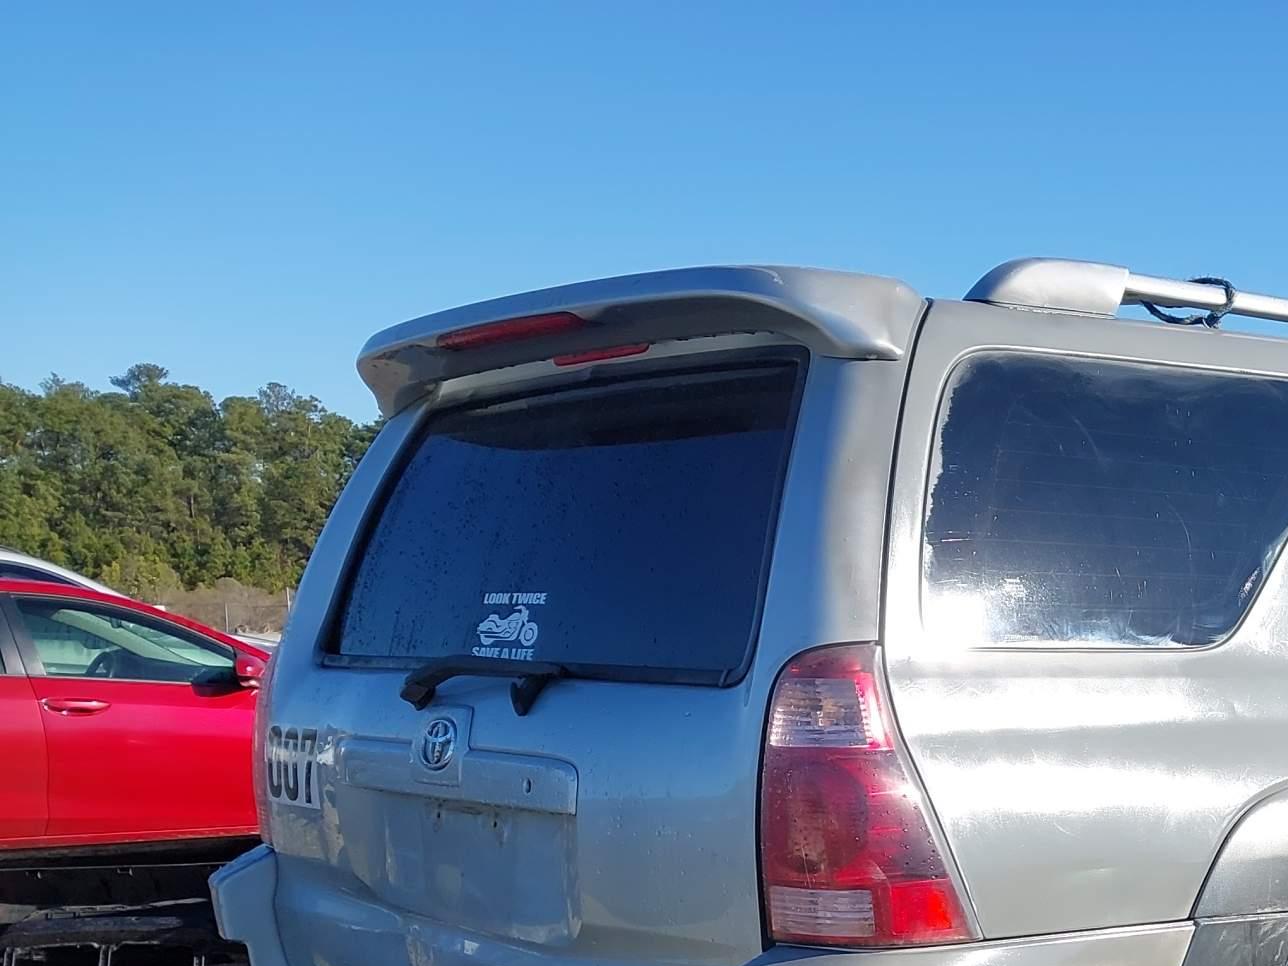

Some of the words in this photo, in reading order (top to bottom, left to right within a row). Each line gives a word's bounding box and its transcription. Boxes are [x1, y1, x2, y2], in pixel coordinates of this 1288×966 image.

[483, 592, 511, 605] LOOK
[512, 592, 547, 605] TWICE
[471, 646, 501, 659] SAVE
[501, 647, 510, 659] A
[510, 648, 535, 661] LIFE
